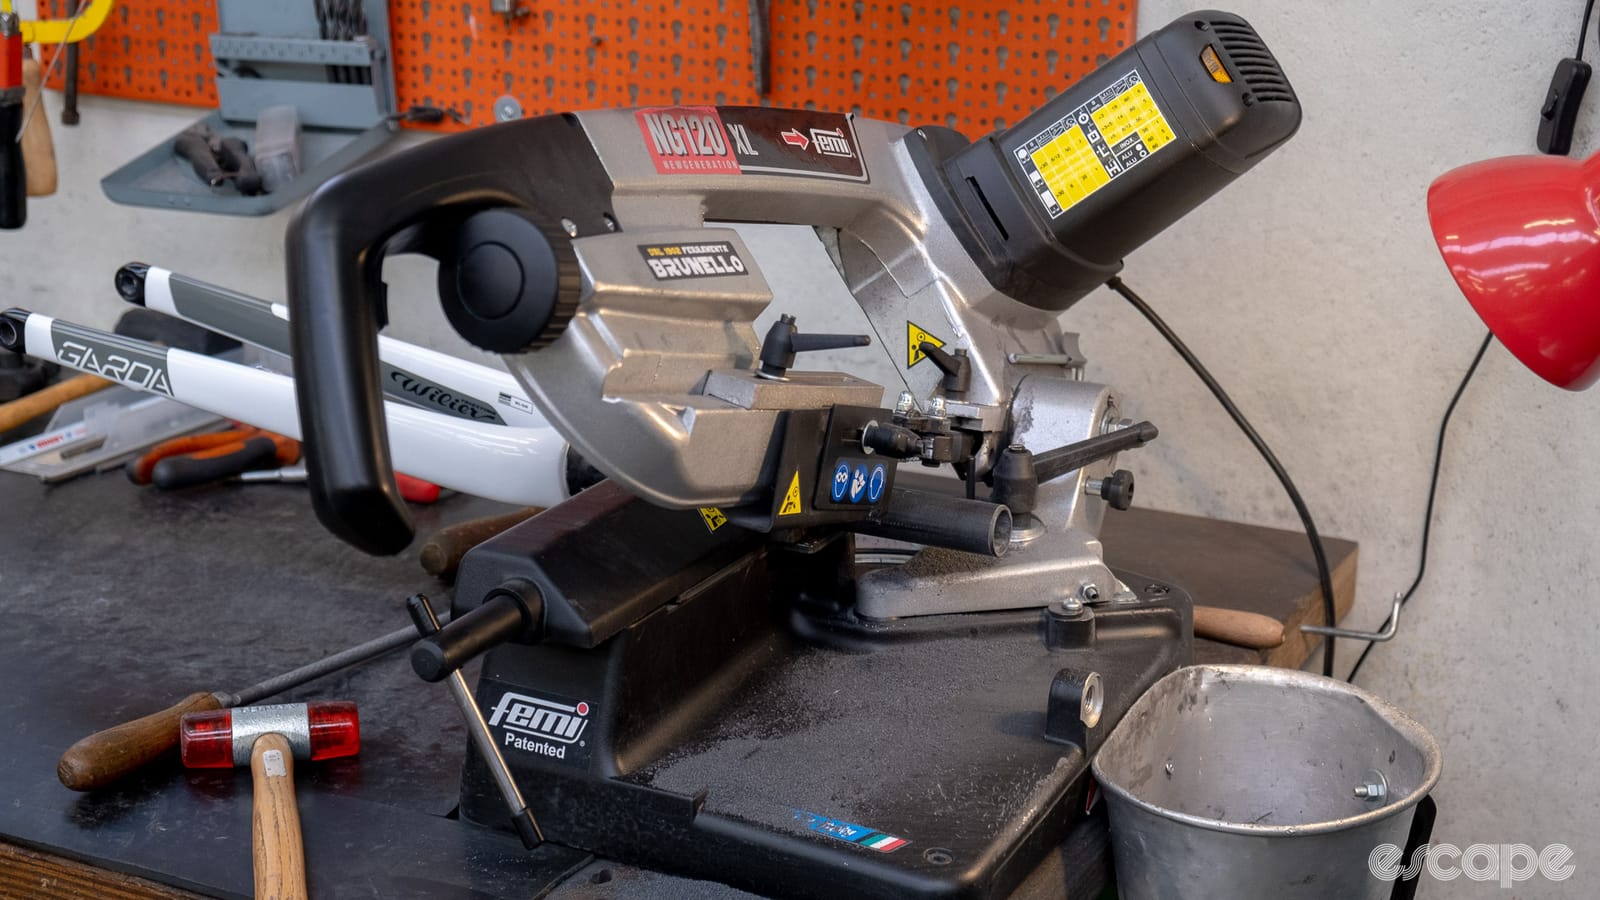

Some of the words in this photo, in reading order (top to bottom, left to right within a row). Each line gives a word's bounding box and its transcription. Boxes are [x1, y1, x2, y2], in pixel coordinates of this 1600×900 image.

[644, 112, 727, 157] NG120
[727, 123, 758, 156] XL
[809, 127, 854, 158] femi
[1119, 137, 1134, 149] INOX
[663, 160, 738, 170] NEWGENERATION
[1121, 150, 1133, 161] ALU
[1126, 157, 1137, 168] ALU
[647, 255, 744, 278] BRUNELLO
[58, 341, 174, 398] GARDA
[391, 371, 495, 420] Wilier
[488, 692, 589, 744] femi
[505, 732, 566, 760] Patented
